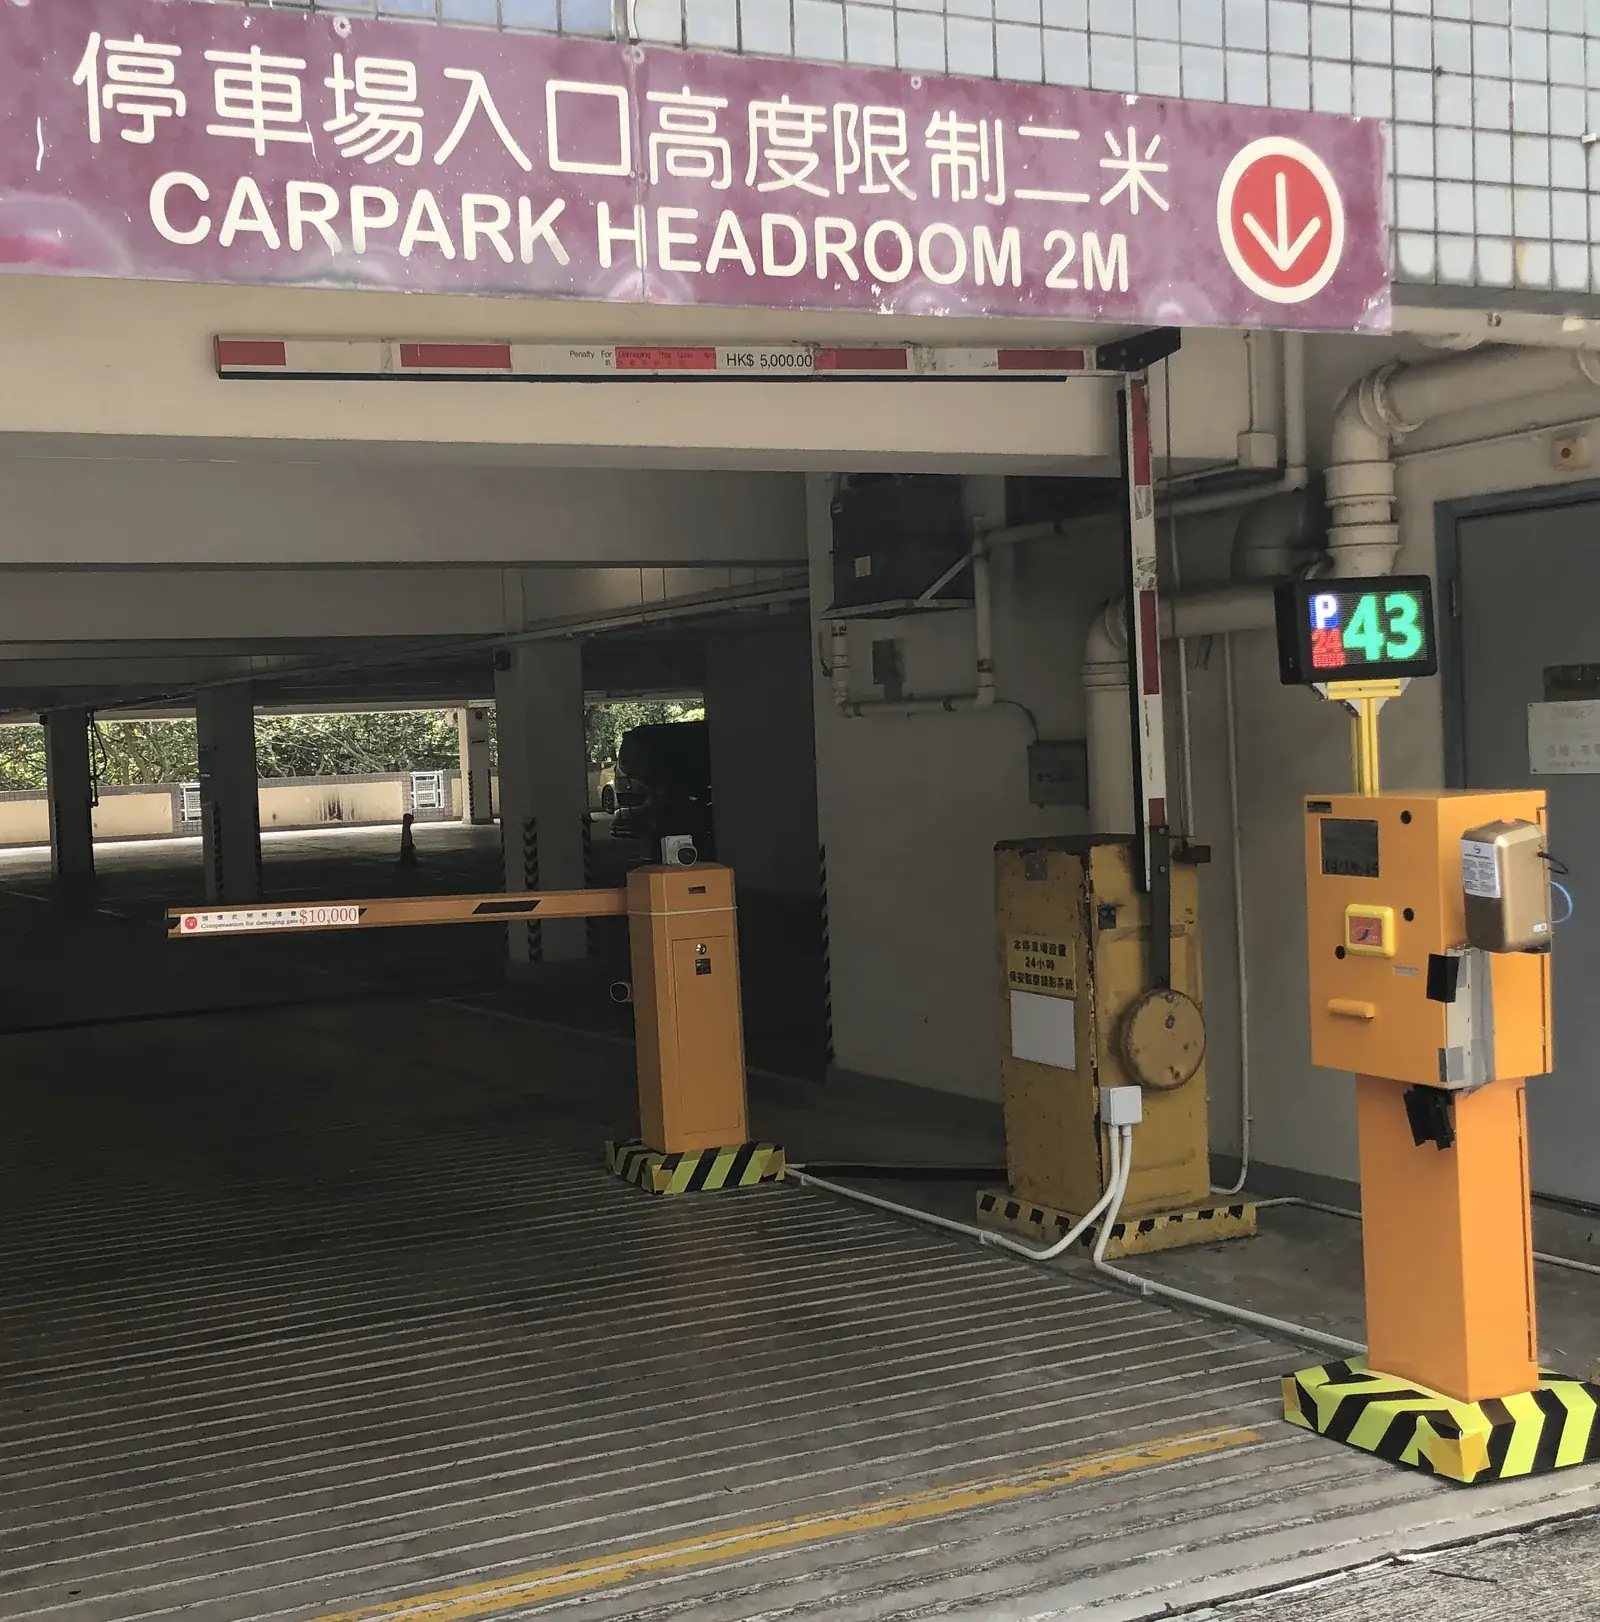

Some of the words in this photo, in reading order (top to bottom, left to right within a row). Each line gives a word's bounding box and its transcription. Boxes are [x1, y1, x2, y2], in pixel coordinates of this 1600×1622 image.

[73, 31, 1170, 216] 停車場入口高度限制二米
[149, 171, 570, 266] CARPARK
[597, 201, 1024, 288] HEADROOM
[1043, 229, 1130, 293] 2M
[569, 350, 595, 358] Penalty
[601, 350, 613, 358] For
[726, 353, 755, 367] HK$
[760, 354, 813, 369] 5,000.00
[1314, 594, 1338, 629] P
[1343, 592, 1422, 661] 43
[201, 920, 244, 929] Compensation
[256, 919, 286, 927] damaging
[300, 907, 358, 926] $10,000
[1025, 956, 1055, 971] 24小時
